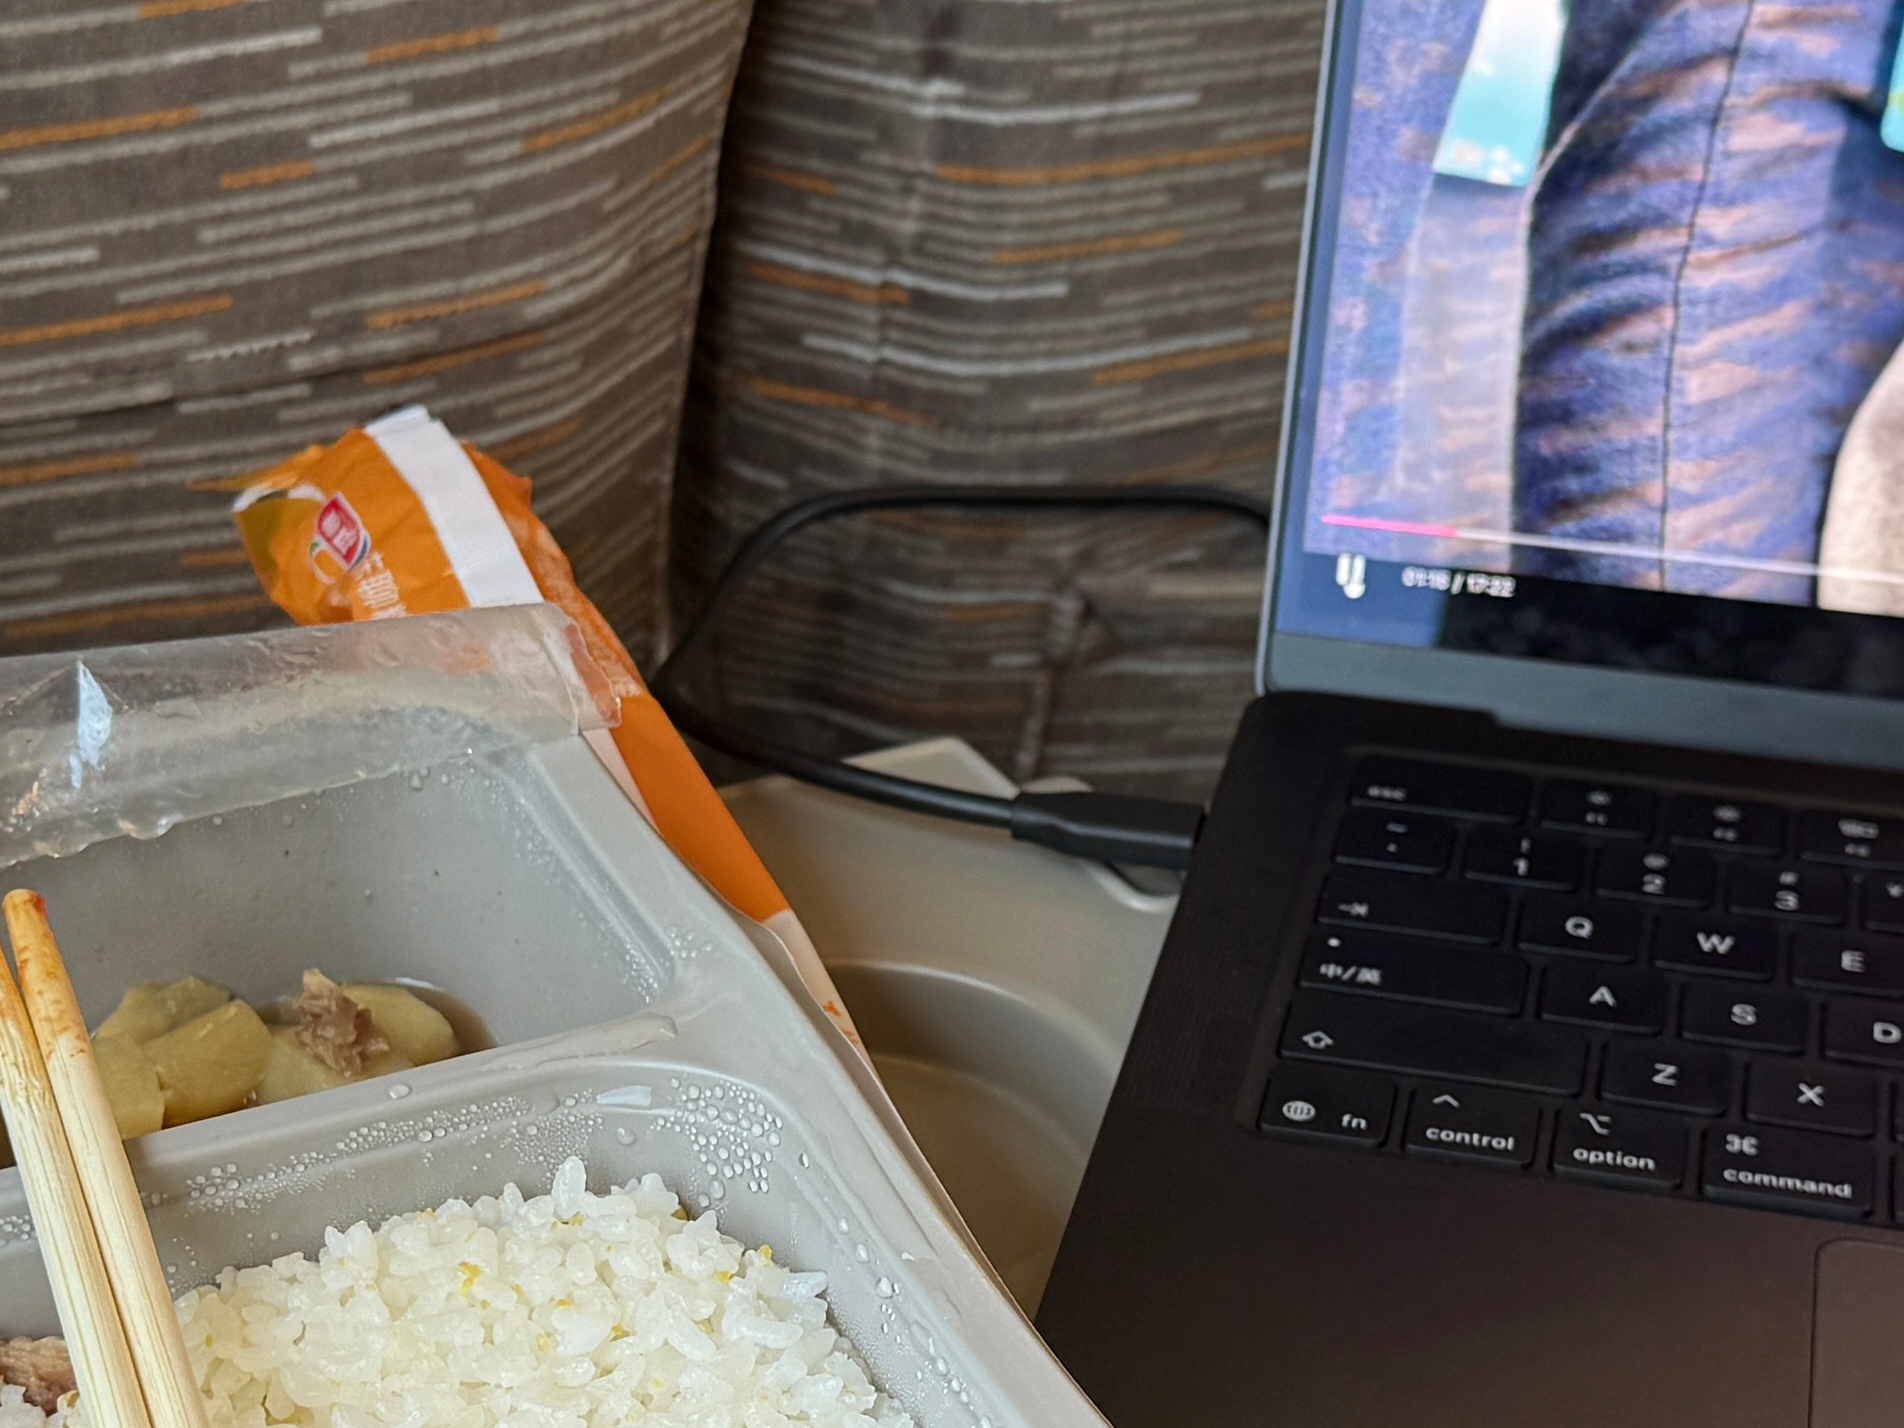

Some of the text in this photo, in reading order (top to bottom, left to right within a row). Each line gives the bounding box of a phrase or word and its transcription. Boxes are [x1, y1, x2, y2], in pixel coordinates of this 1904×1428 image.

[1514, 858, 1528, 876] 1
[1642, 874, 1665, 894] 2
[1775, 890, 1799, 911] 3
[1565, 916, 1593, 939] Q
[1696, 932, 1734, 955] W
[1841, 950, 1863, 972] E
[1589, 986, 1616, 1007] A
[1730, 1003, 1757, 1025] S
[1873, 1021, 1902, 1044] D
[1652, 1063, 1677, 1086] Z
[1797, 1083, 1823, 1106] X
[1341, 1113, 1367, 1130] fn
[1425, 1127, 1515, 1151] control
[1573, 1148, 1655, 1171] option
[1723, 1168, 1852, 1199] command
